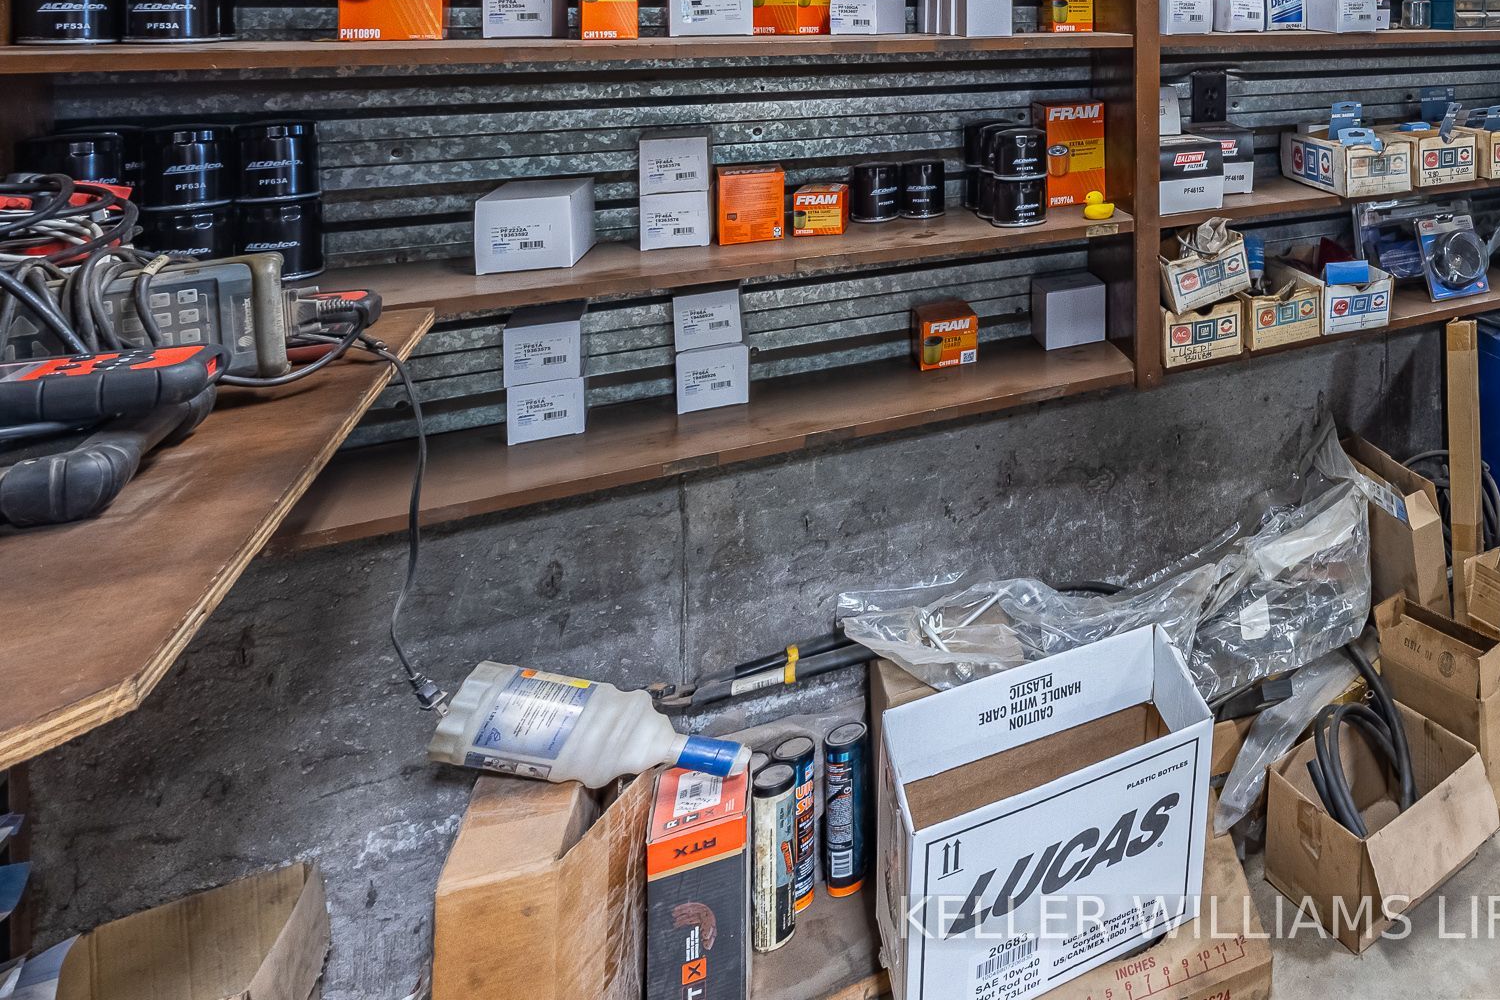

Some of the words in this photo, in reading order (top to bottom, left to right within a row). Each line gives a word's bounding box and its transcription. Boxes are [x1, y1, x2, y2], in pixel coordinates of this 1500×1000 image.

[37, 2, 108, 13] ACDelco
[133, 1, 197, 12] ACDelco
[56, 21, 91, 31] PF53A
[146, 21, 180, 30] PF53A
[340, 29, 380, 39] PH10890
[584, 30, 617, 39] CH11955
[1049, 105, 1100, 121] FRAM
[246, 159, 303, 171] ACDelco
[1177, 152, 1204, 163] BALDWIN
[163, 162, 224, 175] ACDelco
[175, 182, 206, 191] PF63A
[258, 177, 288, 185] PF63A
[1183, 186, 1205, 195] PF46152
[796, 194, 838, 206] FRAM
[245, 240, 301, 251] ACDelco
[930, 318, 970, 334] FRAM
[1009, 675, 1053, 700] PLASTIC
[1041, 680, 1082, 705] HANDLE
[1009, 692, 1038, 715] WITH
[978, 701, 1005, 727] CARE
[1009, 705, 1053, 731] CAUTION
[1126, 772, 1156, 790] PLASTIC
[1157, 760, 1189, 780] BOTTLES
[673, 837, 717, 859] RTX
[944, 792, 1181, 941] LUCAS
[1142, 899, 1158, 913] Inc.
[1072, 930, 1109, 950] Corydon,
[1110, 924, 1120, 935] IN
[988, 932, 1029, 959] 20683
[1052, 937, 1105, 967] US/CAN/MEX
[1106, 926, 1128, 945] (800)
[1105, 988, 1113, 999] 5
[1124, 981, 1133, 991] 6
[1144, 974, 1151, 984] 7
[1162, 966, 1170, 976] 8
[1181, 958, 1189, 969] 9
[1196, 950, 1211, 962] 10
[1214, 942, 1227, 954] 11
[1234, 934, 1247, 947] 12
[1115, 957, 1157, 981] INCHES
[975, 977, 999, 995] SAE
[1003, 957, 1040, 981] 10w-40
[998, 979, 1020, 992] Rod
[1023, 969, 1039, 982] Oil
